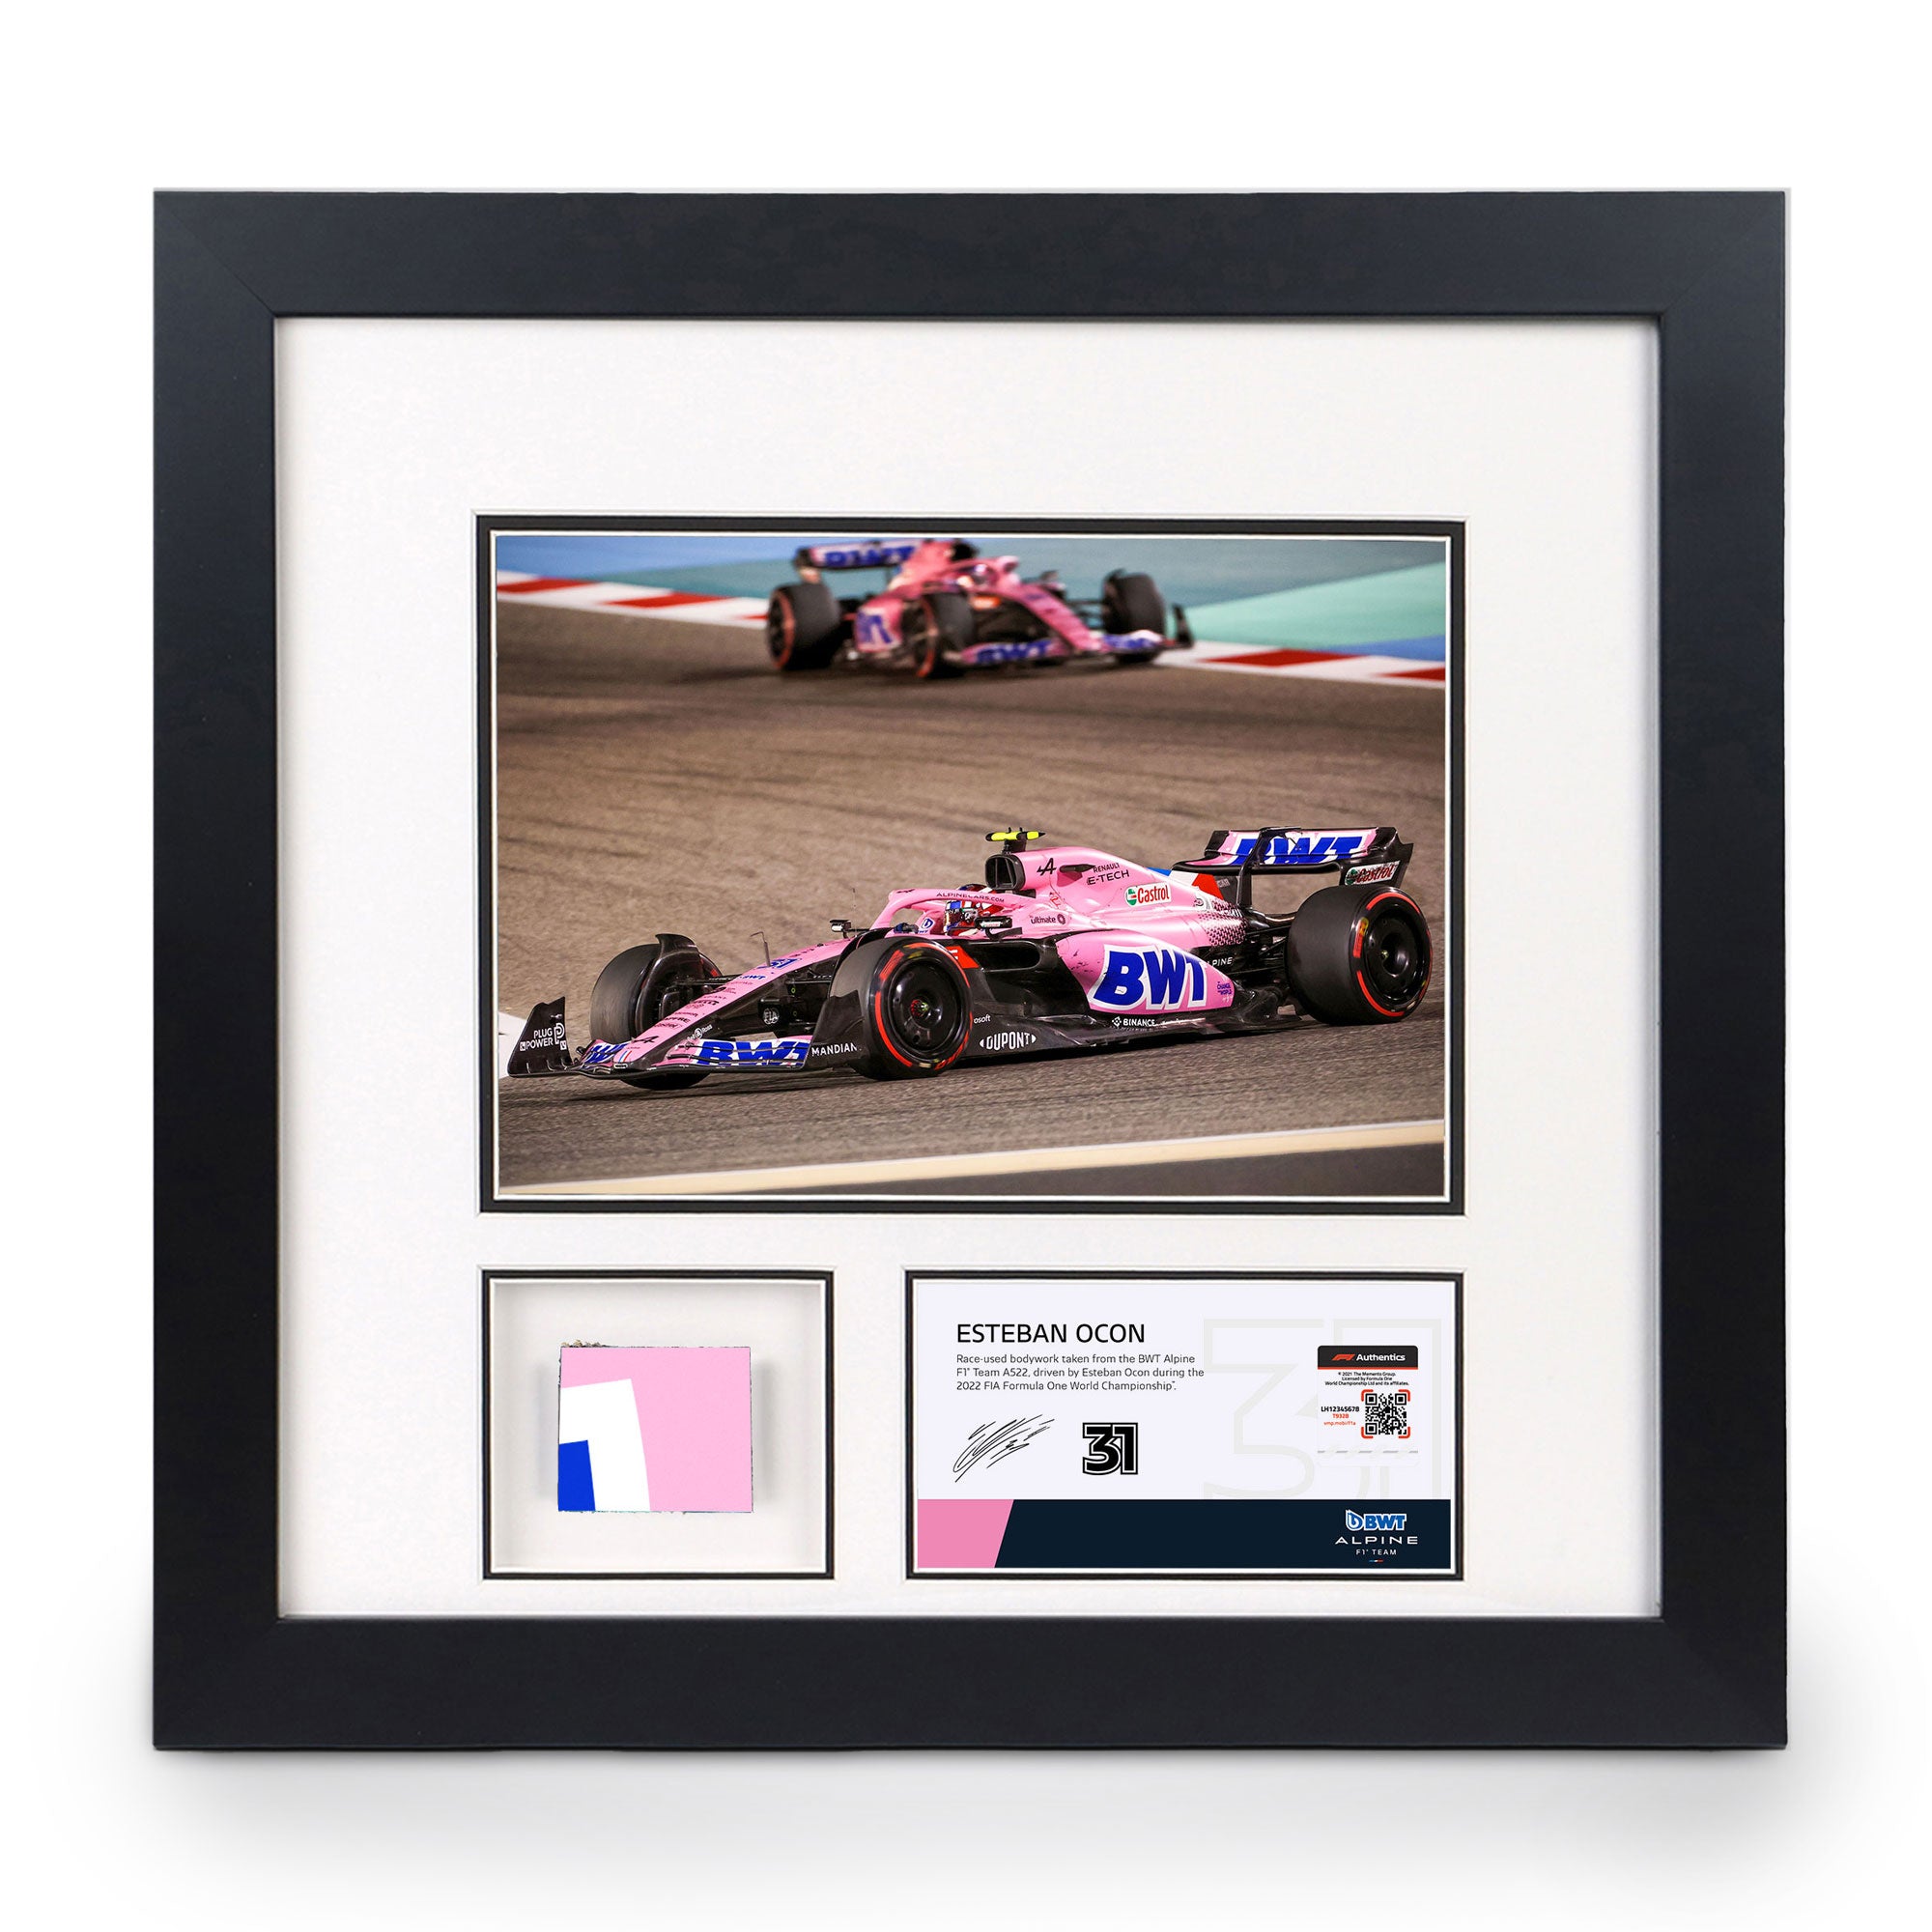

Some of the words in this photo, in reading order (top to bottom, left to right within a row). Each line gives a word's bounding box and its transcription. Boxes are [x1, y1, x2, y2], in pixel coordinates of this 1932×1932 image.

[1093, 863, 1121, 873] RENAULT
[1087, 869, 1130, 886] E-TECH
[1356, 865, 1396, 884] Castrol
[1137, 886, 1170, 904] Castrol
[1030, 915, 1057, 924] ultimate
[1211, 956, 1234, 967] PINE
[1094, 949, 1205, 1007] BWT
[1122, 1018, 1157, 1027] BINANCE
[533, 1027, 554, 1039] PLUG
[526, 1037, 554, 1050] POWER
[985, 1032, 1031, 1051] DUPONT
[810, 1042, 863, 1058] MANDIAN
[957, 1323, 1067, 1343] ESTEBAN
[1075, 1323, 1145, 1344] OCON
[956, 1353, 1008, 1363] Race-used
[1009, 1353, 1059, 1364] bodywork
[1062, 1354, 1090, 1363] taken
[1092, 1353, 1117, 1363] from
[1119, 1354, 1136, 1363] the
[1138, 1354, 1161, 1363] BWT
[1163, 1353, 1195, 1364] Alpine
[1356, 1352, 1406, 1361] Authentics
[973, 1368, 1000, 1377] Team
[1003, 1368, 1031, 1378] A522,
[1033, 1367, 1065, 1377] driven
[1067, 1367, 1080, 1378] by
[1082, 1367, 1122, 1377] Esteban
[1124, 1368, 1151, 1377] Ocon
[1152, 1367, 1185, 1378] during
[1187, 1368, 1205, 1377] the
[956, 1381, 981, 1390] 2022
[983, 1381, 1001, 1390] FIA
[1003, 1381, 1044, 1390] Formula
[1047, 1381, 1067, 1390] One
[1070, 1381, 1099, 1390] World
[1082, 1422, 1139, 1476] 31
[1364, 1514, 1407, 1530] BWT
[1335, 1536, 1418, 1545] ALPINE
